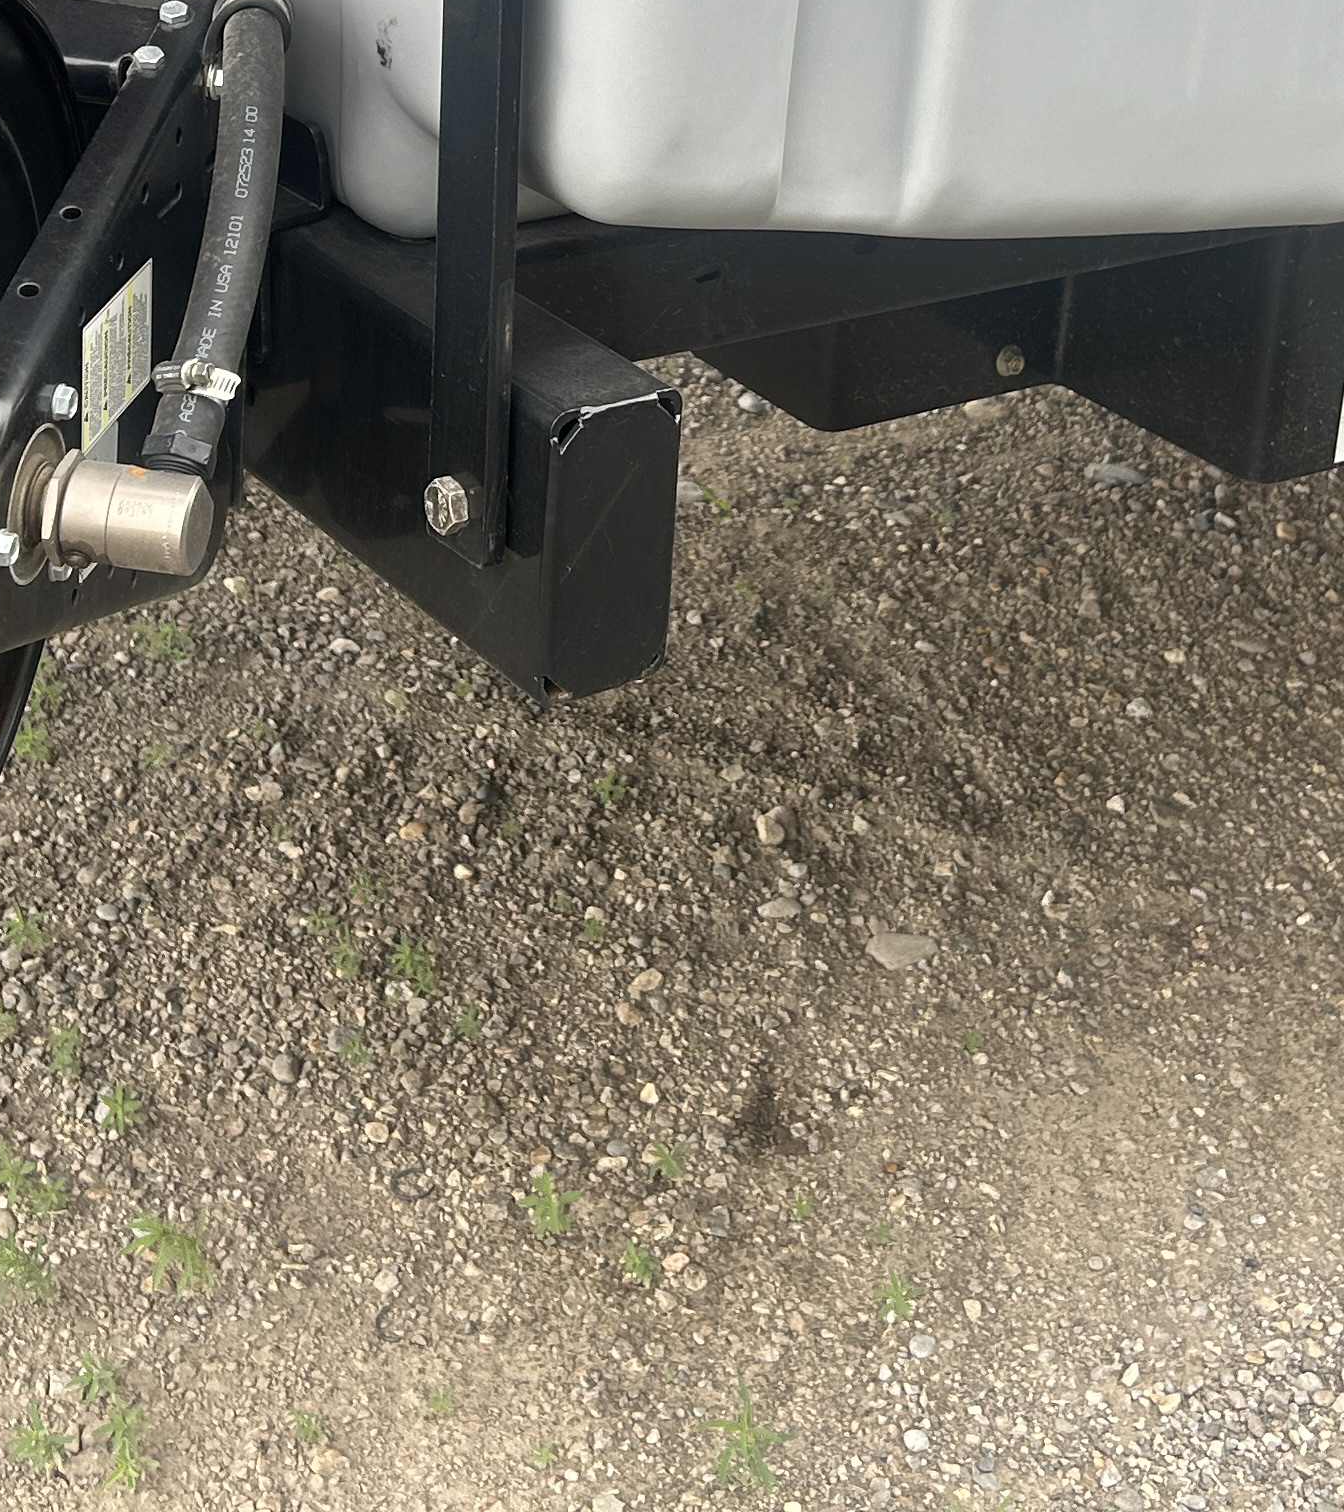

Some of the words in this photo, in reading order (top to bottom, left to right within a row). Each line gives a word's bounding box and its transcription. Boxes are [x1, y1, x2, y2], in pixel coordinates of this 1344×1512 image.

[234, 147, 254, 199] 072523
[223, 215, 245, 255] 12101
[214, 265, 233, 293] USA
[207, 300, 224, 318] IN
[179, 394, 197, 423] AG2
